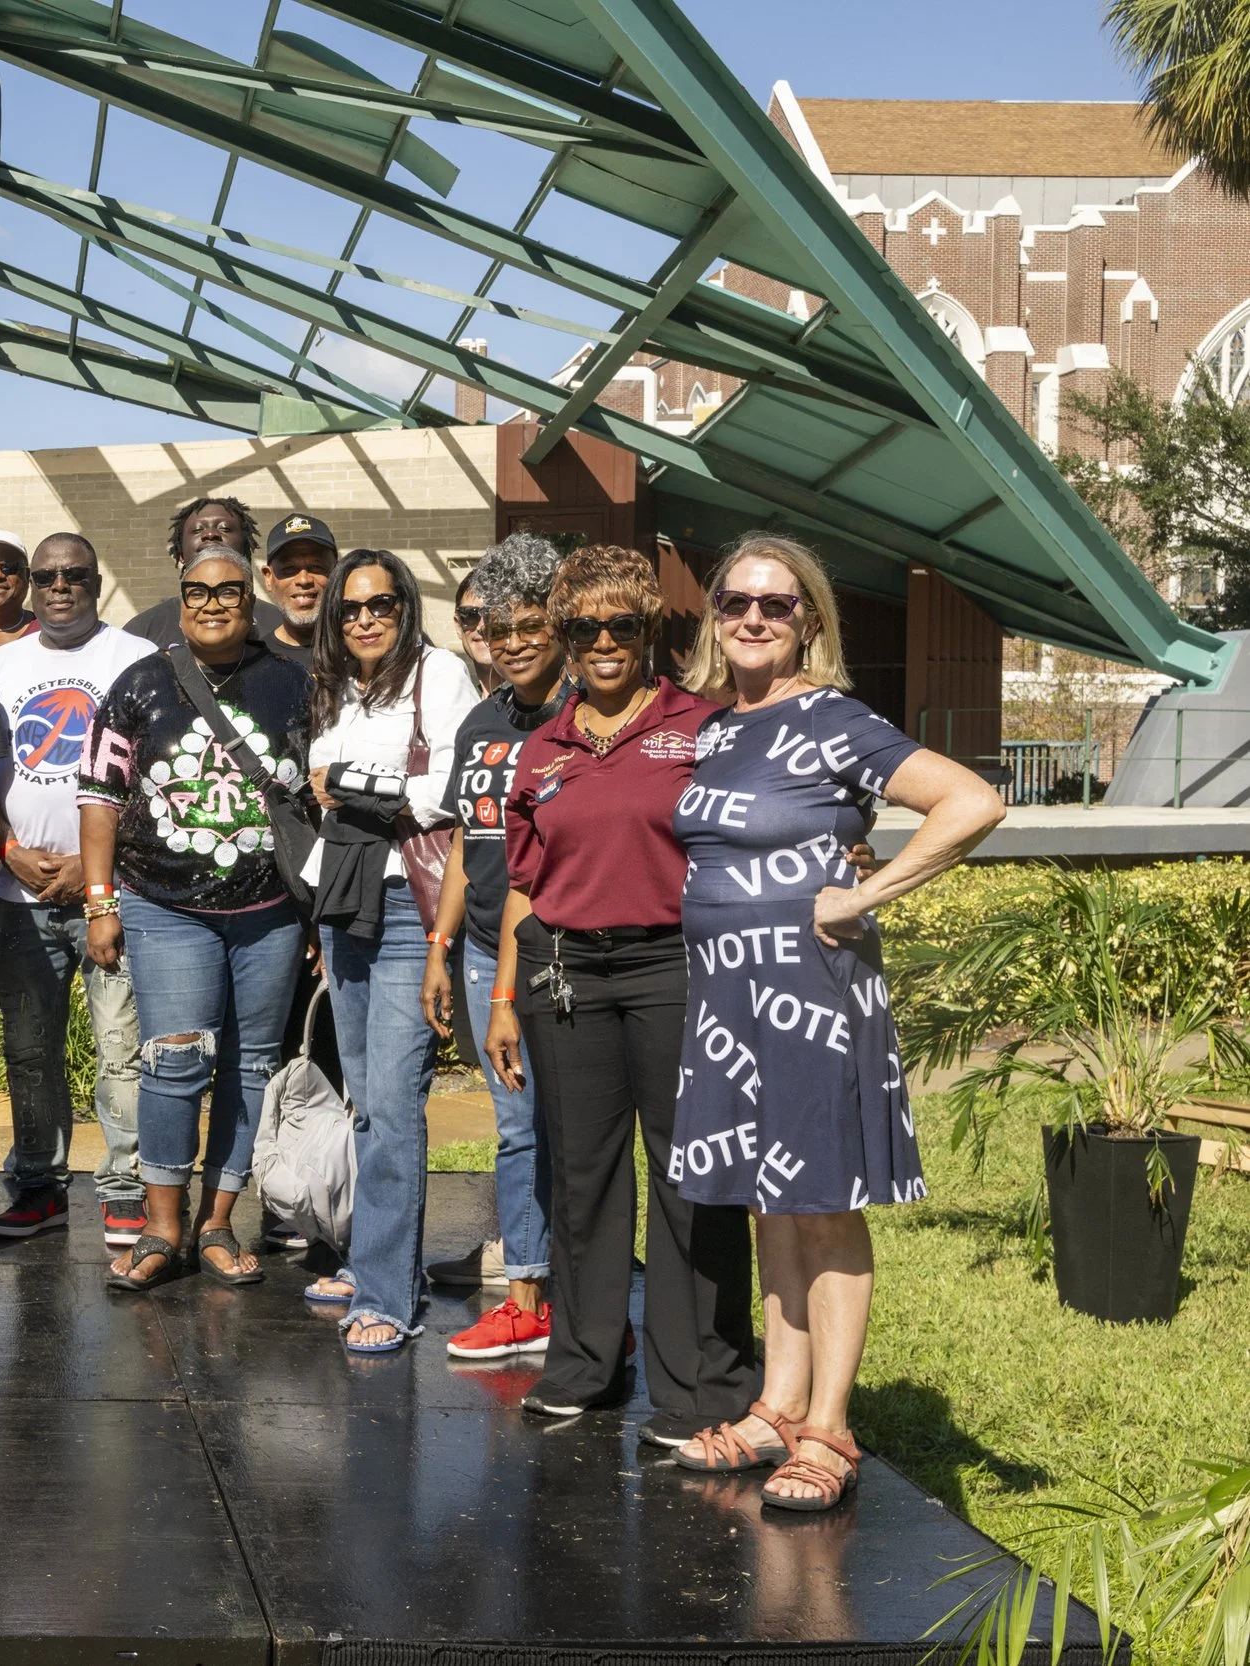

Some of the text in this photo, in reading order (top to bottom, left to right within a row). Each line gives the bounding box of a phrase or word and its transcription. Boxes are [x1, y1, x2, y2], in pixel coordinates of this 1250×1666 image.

[460, 769, 492, 795] TO
[697, 926, 801, 976] VOTE
[749, 979, 851, 1055] VOTE
[696, 1000, 762, 1106] VOTE
